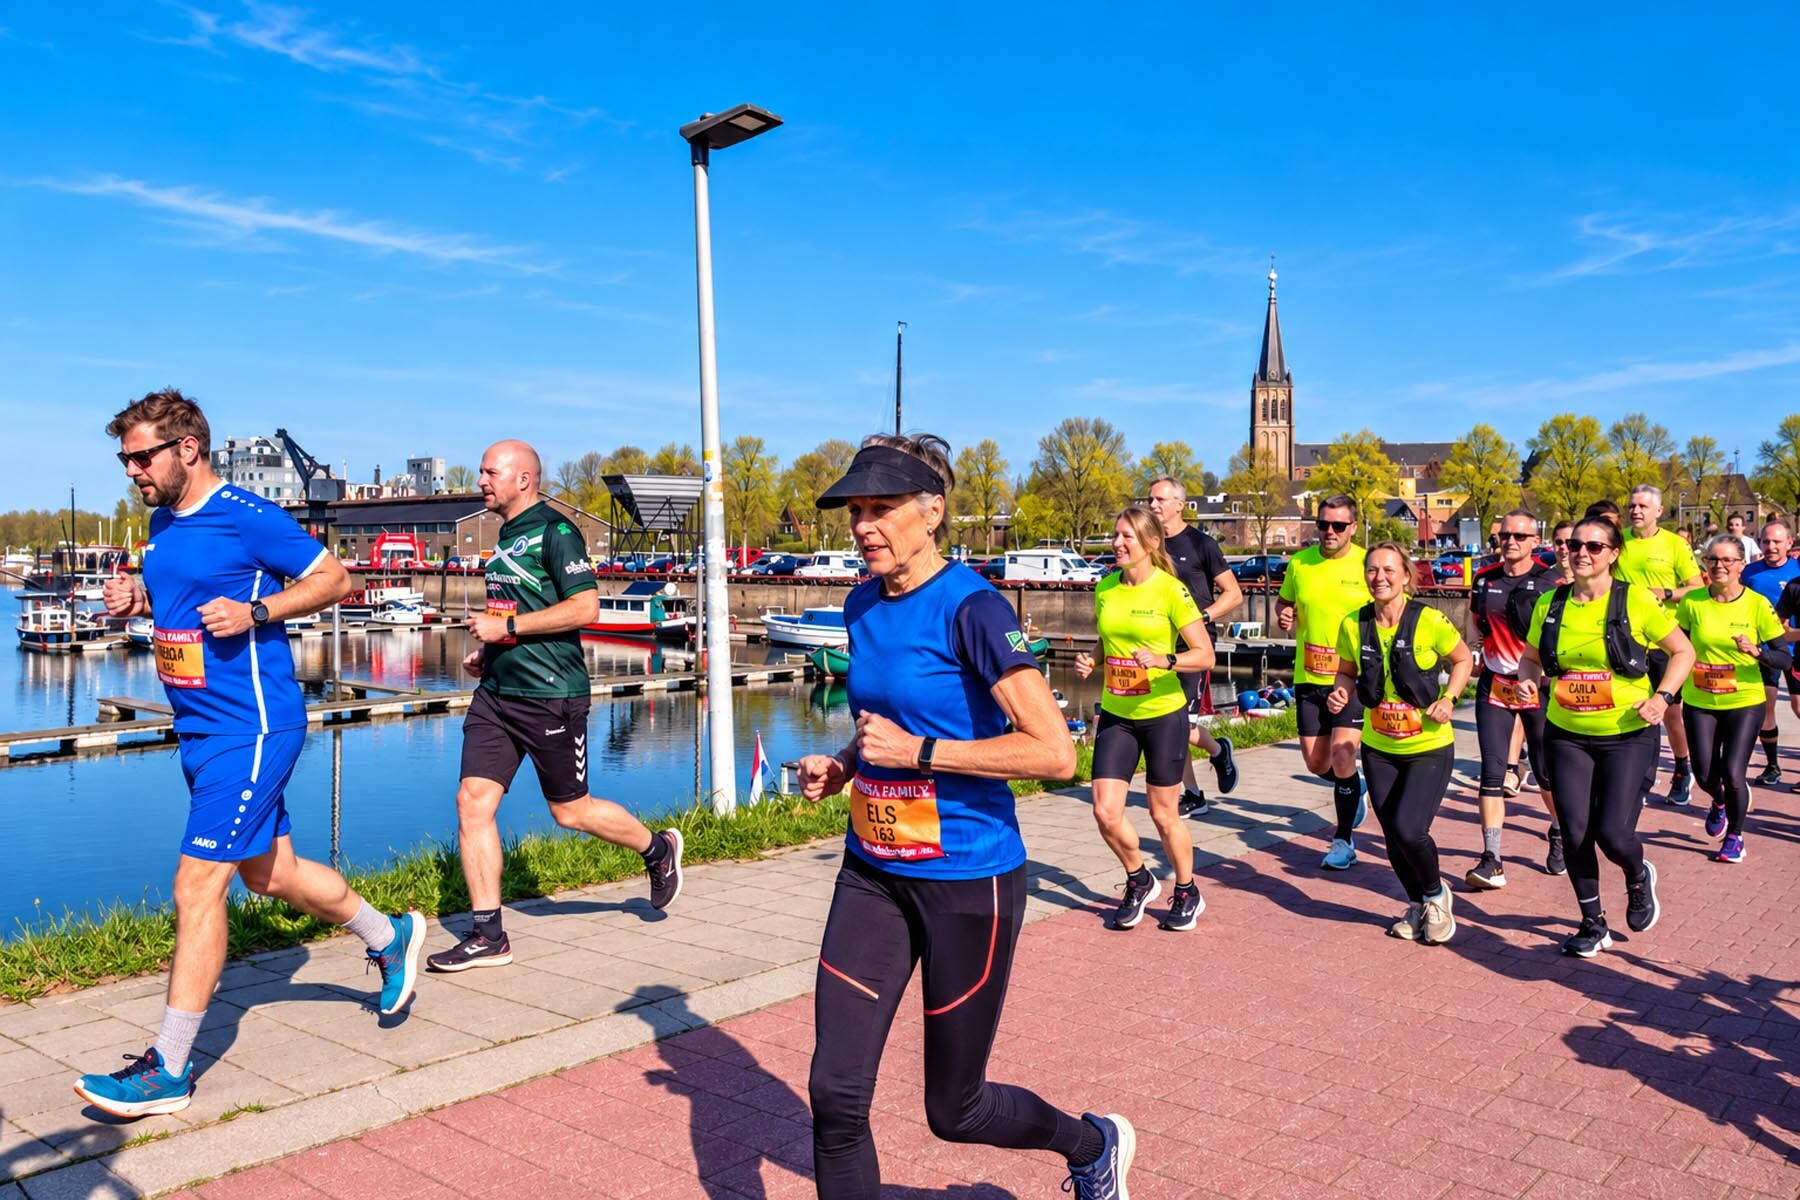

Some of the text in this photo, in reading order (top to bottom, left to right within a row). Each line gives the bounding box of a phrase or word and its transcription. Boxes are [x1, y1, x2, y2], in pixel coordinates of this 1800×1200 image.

[882, 785, 931, 798] FAMILY
[866, 803, 897, 825] ELS
[872, 826, 896, 842] 163
[191, 836, 218, 849] JAKO
